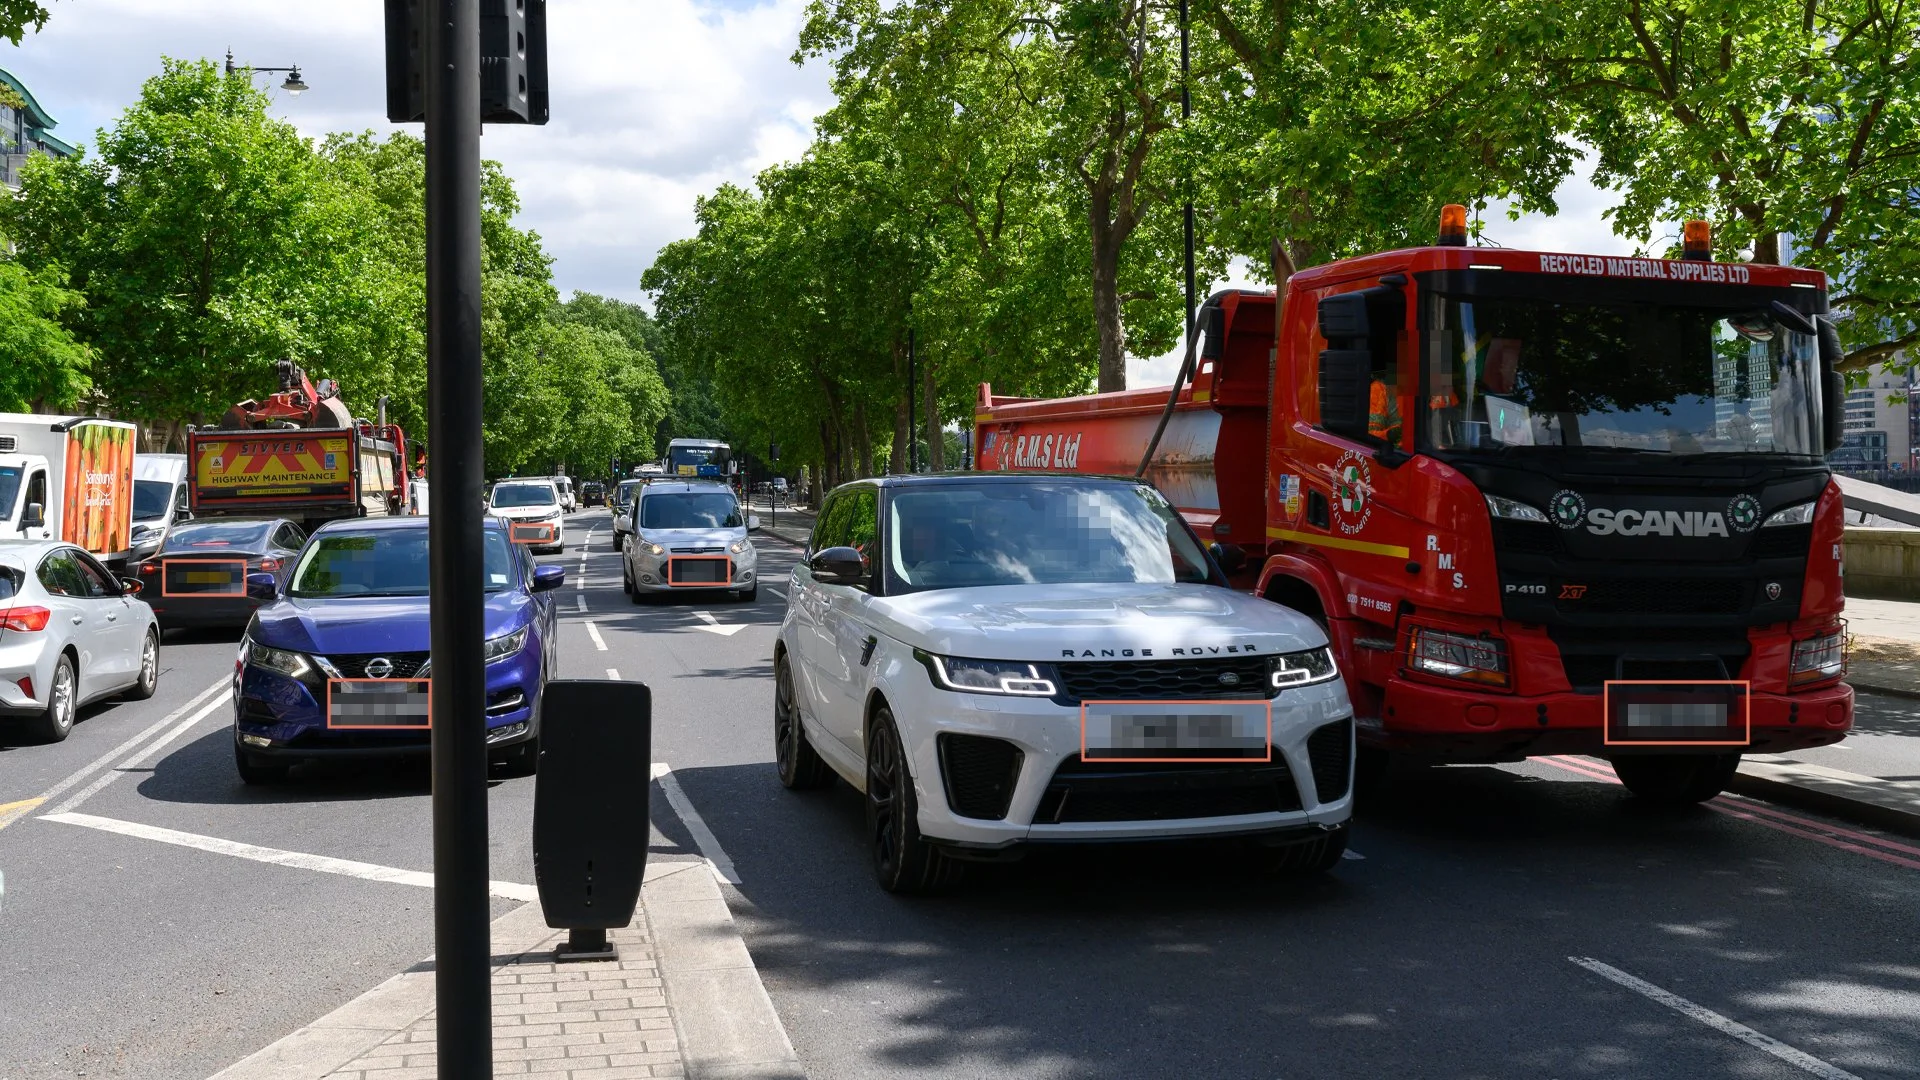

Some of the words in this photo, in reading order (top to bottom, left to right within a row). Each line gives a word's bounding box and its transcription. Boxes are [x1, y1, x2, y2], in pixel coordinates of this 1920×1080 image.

[1540, 254, 1604, 275] RECYCLED
[1607, 259, 1668, 279] MATERIAL
[1670, 263, 1726, 283] SUPPLIES
[1728, 266, 1749, 284] LTD
[241, 442, 305, 455] SIVYER
[1014, 433, 1053, 468] R.M.S
[1054, 433, 1082, 469] Ltd
[212, 475, 259, 483] HIGHWAY
[262, 472, 336, 482] MAINTENANCE
[1355, 451, 1373, 504] MATERIAL
[1332, 502, 1342, 524] LTD
[1340, 508, 1372, 535] SUPPLIES
[1586, 508, 1730, 538] SCANIA
[1558, 585, 1587, 599] XT
[1360, 596, 1375, 608] 7511
[1375, 600, 1392, 612] 8565
[1062, 648, 1153, 658] RANGE
[1172, 644, 1257, 656] ROVER
